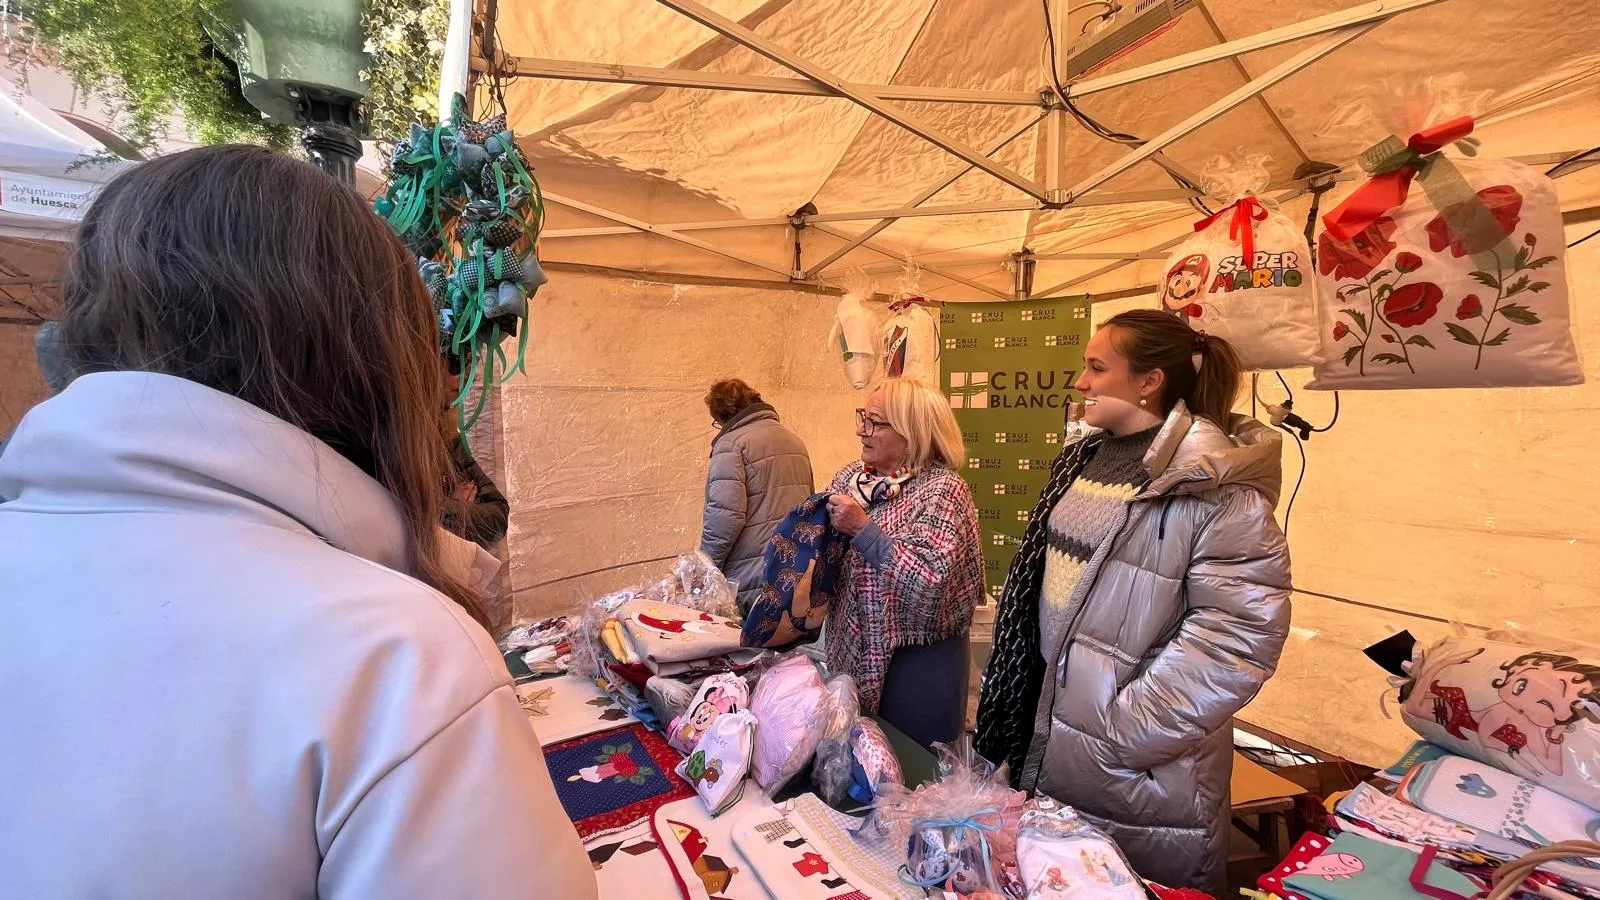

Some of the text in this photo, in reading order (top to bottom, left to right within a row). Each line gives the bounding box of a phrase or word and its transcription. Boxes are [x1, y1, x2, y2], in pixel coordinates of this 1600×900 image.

[11, 194, 78, 209] de Huesca
[1208, 267, 1303, 293] MARIO
[990, 370, 1077, 391] CRUZ
[990, 394, 1073, 408] BLANCA
